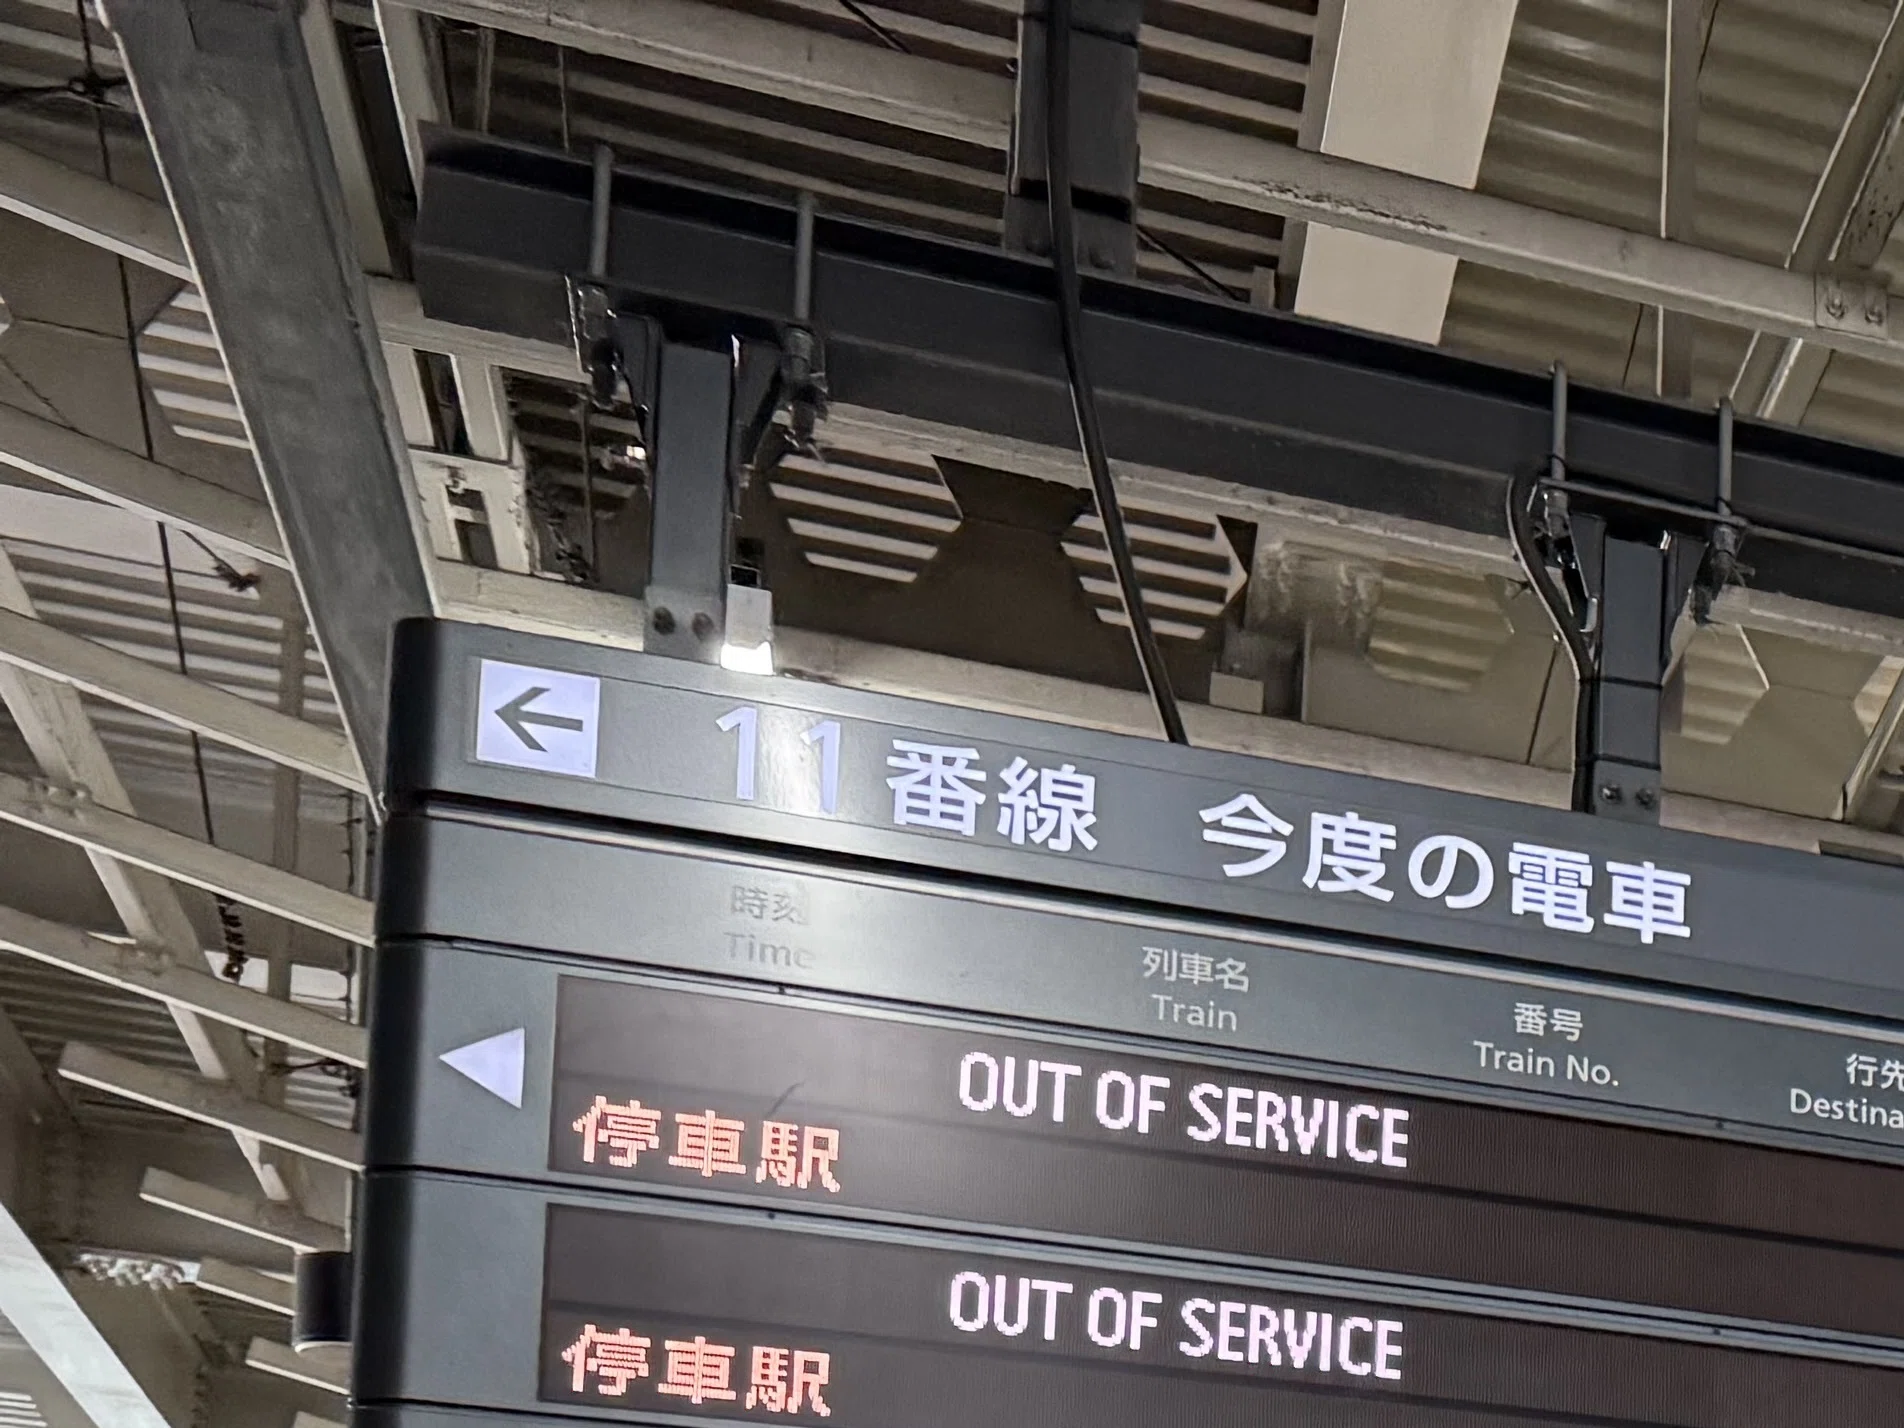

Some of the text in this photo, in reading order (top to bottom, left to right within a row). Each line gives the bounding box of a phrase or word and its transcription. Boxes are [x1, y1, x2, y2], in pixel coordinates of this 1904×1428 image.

[1199, 793, 1692, 943] 今度の電車
[723, 931, 816, 970] Time
[1142, 946, 1250, 993] 列車名
[1151, 994, 1238, 1032] Train
[1514, 1002, 1583, 1042] 番号
[1473, 1040, 1619, 1087] Train No.
[573, 1095, 841, 1193] 停車駅
[959, 1050, 1409, 1168] OUT OF SERVICE
[949, 1270, 1404, 1380] OUT OF SERVICE
[562, 1324, 832, 1417] 停車駅
